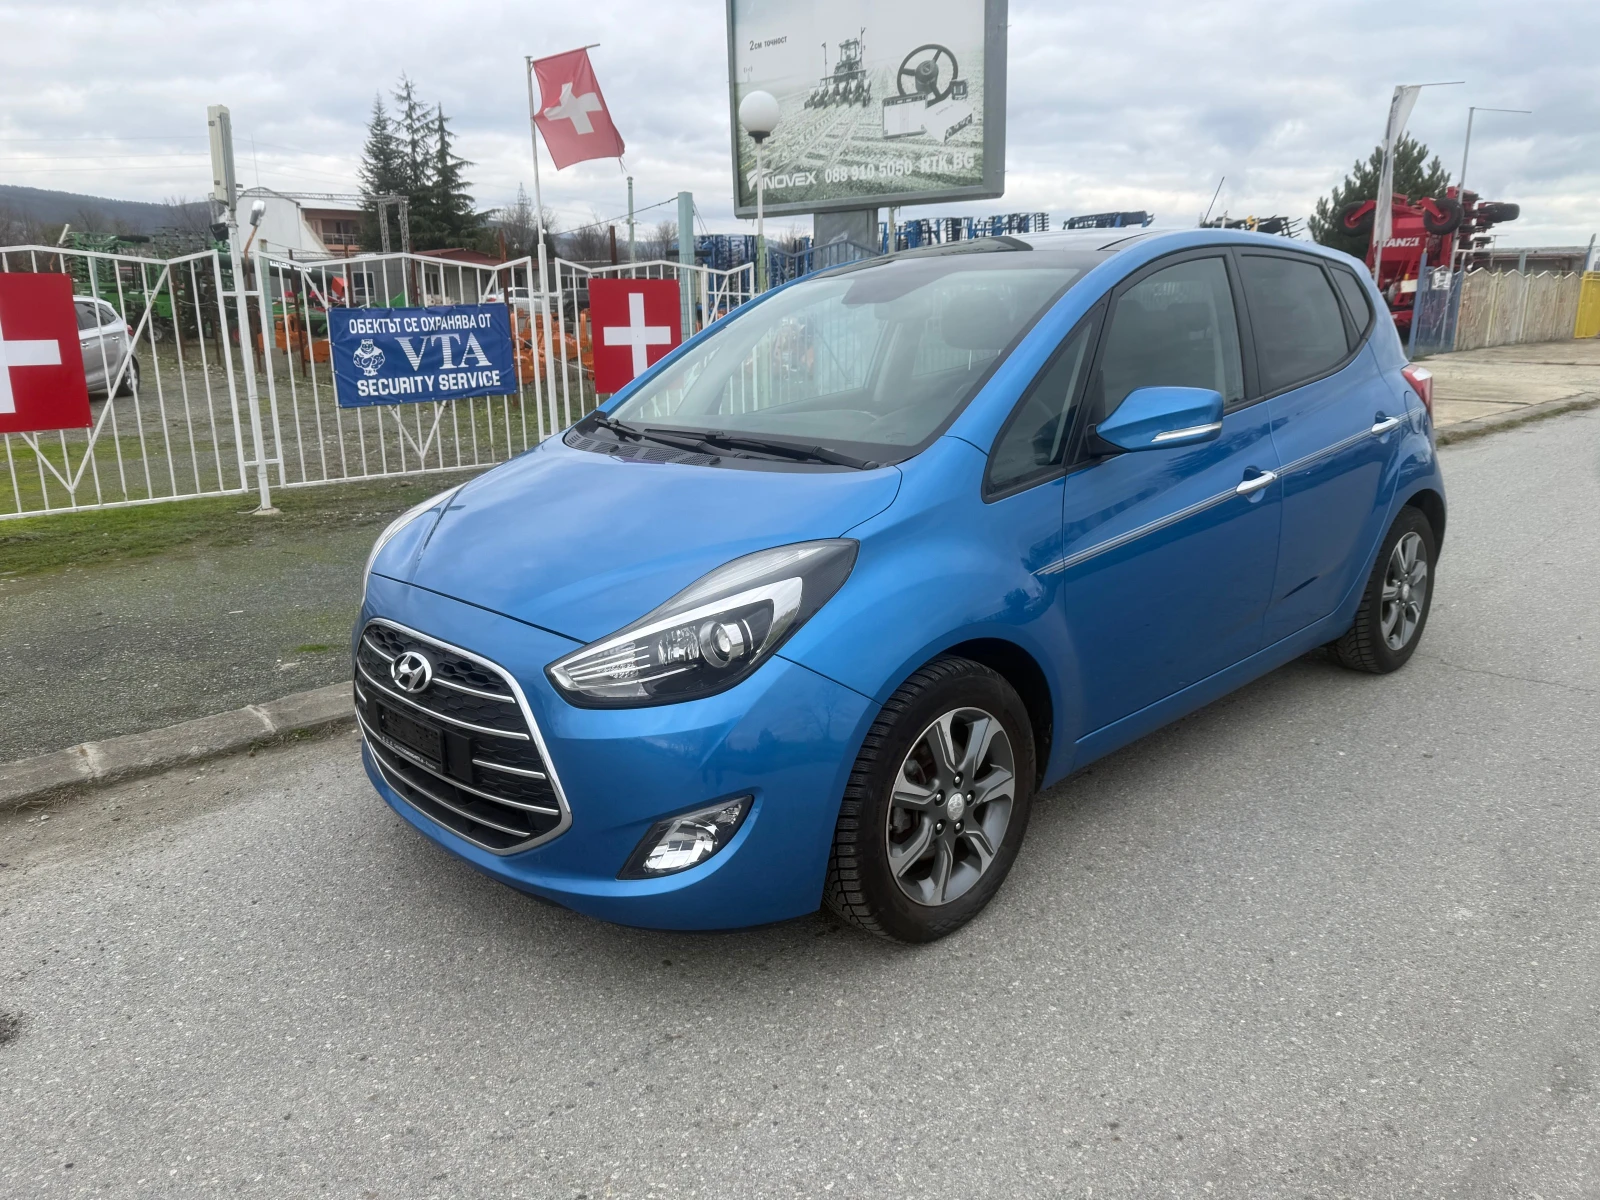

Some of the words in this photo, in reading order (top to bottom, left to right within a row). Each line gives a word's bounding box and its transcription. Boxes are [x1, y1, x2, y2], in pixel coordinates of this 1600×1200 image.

[749, 40, 762, 51] 2см
[824, 168, 848, 184] 088
[850, 163, 875, 181] 910
[878, 159, 913, 178] 5050
[920, 153, 975, 174] RTK.BG
[349, 318, 401, 335] ОБЕКТЪТ
[403, 318, 419, 331] СЕ
[420, 314, 476, 332] ОХРАНЯВА
[479, 313, 491, 328] ОТ
[394, 332, 492, 372] VTA
[357, 374, 435, 397] SECURITY
[438, 370, 501, 391] SERVICE
